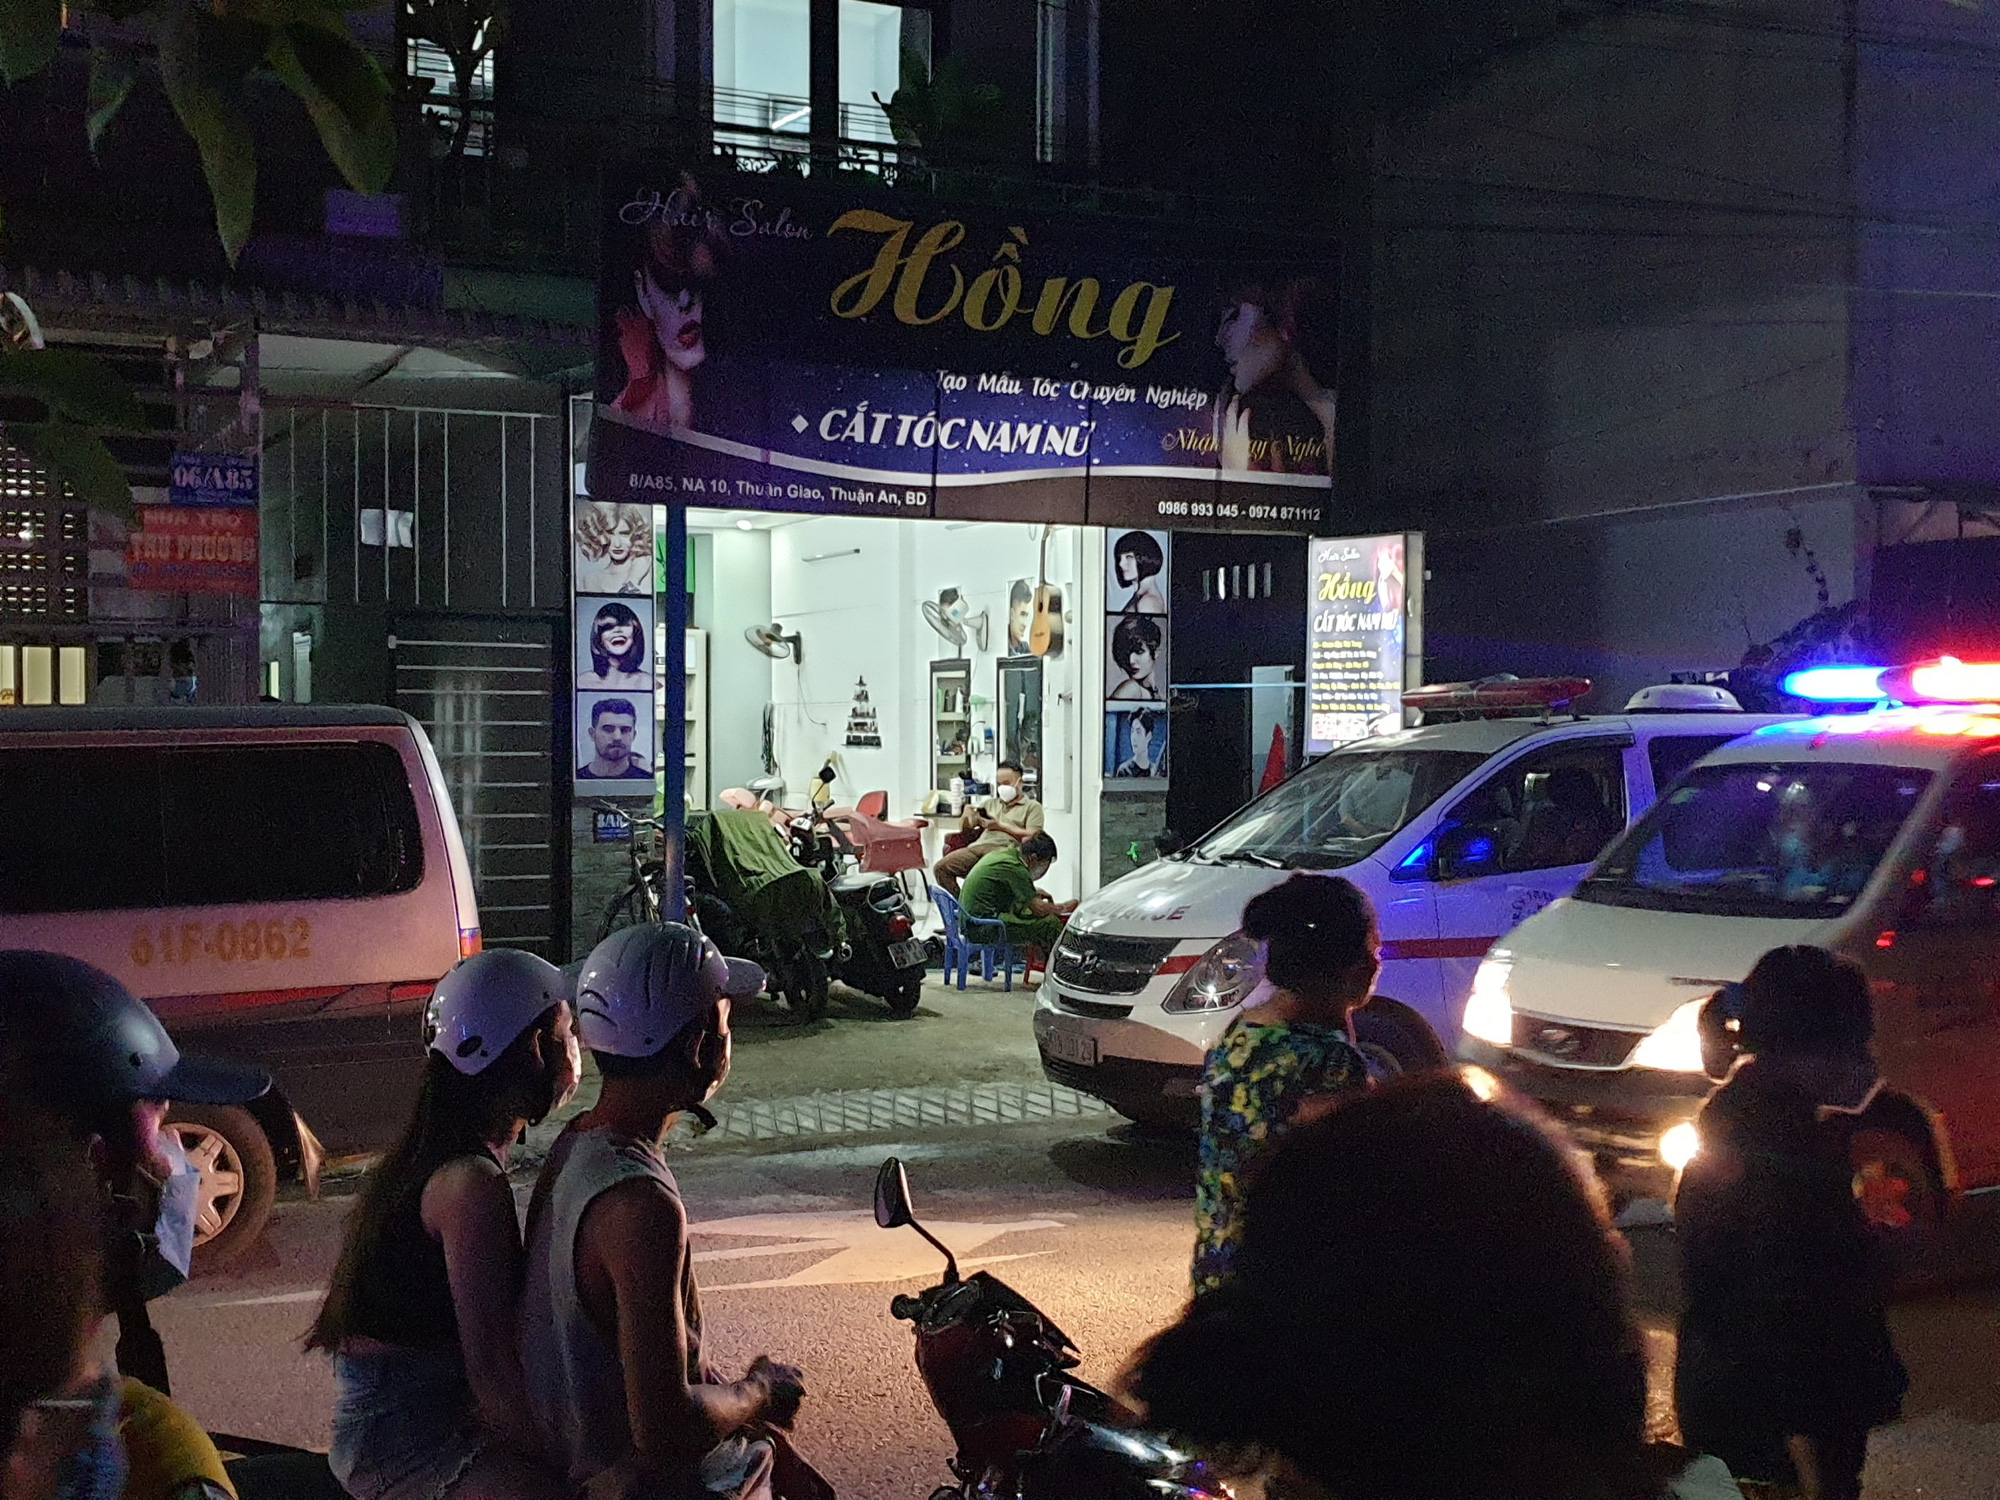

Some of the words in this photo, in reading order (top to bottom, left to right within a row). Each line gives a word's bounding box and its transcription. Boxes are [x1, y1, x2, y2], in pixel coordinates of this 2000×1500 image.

[826, 209, 1182, 369] Hồng
[936, 369, 967, 394] Tạo
[1032, 376, 1061, 397] Tóc
[1145, 386, 1208, 411] Nghiệp
[819, 400, 893, 444] CẮT
[896, 410, 966, 448] TÓC
[966, 420, 1042, 455] NAM
[628, 473, 677, 492] 8/A85,
[682, 477, 706, 493] NA
[710, 479, 731, 496] 10,
[786, 483, 825, 502] Giao,
[829, 486, 874, 506] Thuận
[877, 489, 902, 507] An,
[905, 490, 927, 506] BD
[1157, 501, 1188, 516] 0986
[1191, 502, 1213, 516] 993
[1216, 503, 1239, 518] 045
[1248, 505, 1277, 519] 0974
[1318, 571, 1378, 605] Hồng
[131, 916, 311, 968] 61F-0862
